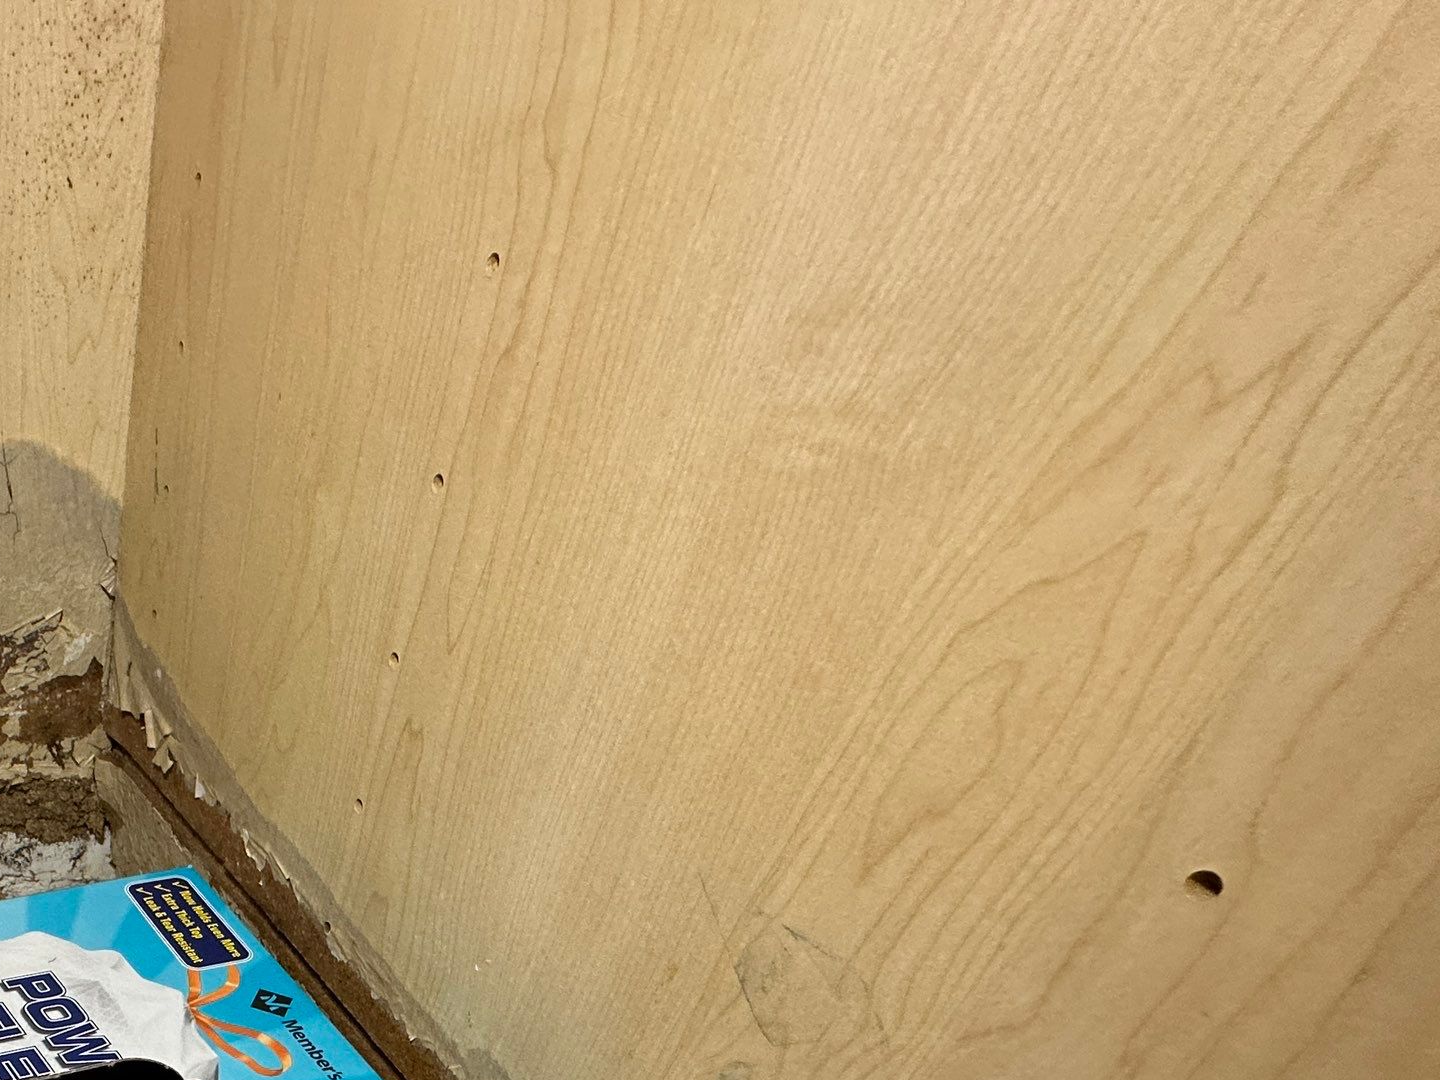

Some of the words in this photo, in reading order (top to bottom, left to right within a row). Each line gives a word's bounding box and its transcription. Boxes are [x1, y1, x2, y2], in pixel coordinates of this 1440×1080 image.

[142, 895, 161, 912] Leak
[160, 917, 176, 932] Tear
[171, 932, 203, 963] Resistant
[160, 893, 180, 910] Extra
[175, 909, 194, 926] Thick
[189, 925, 203, 939] Top
[191, 905, 212, 923] Holds
[206, 922, 226, 938] Even
[220, 938, 241, 957] More
[281, 1017, 342, 1080] Member's
